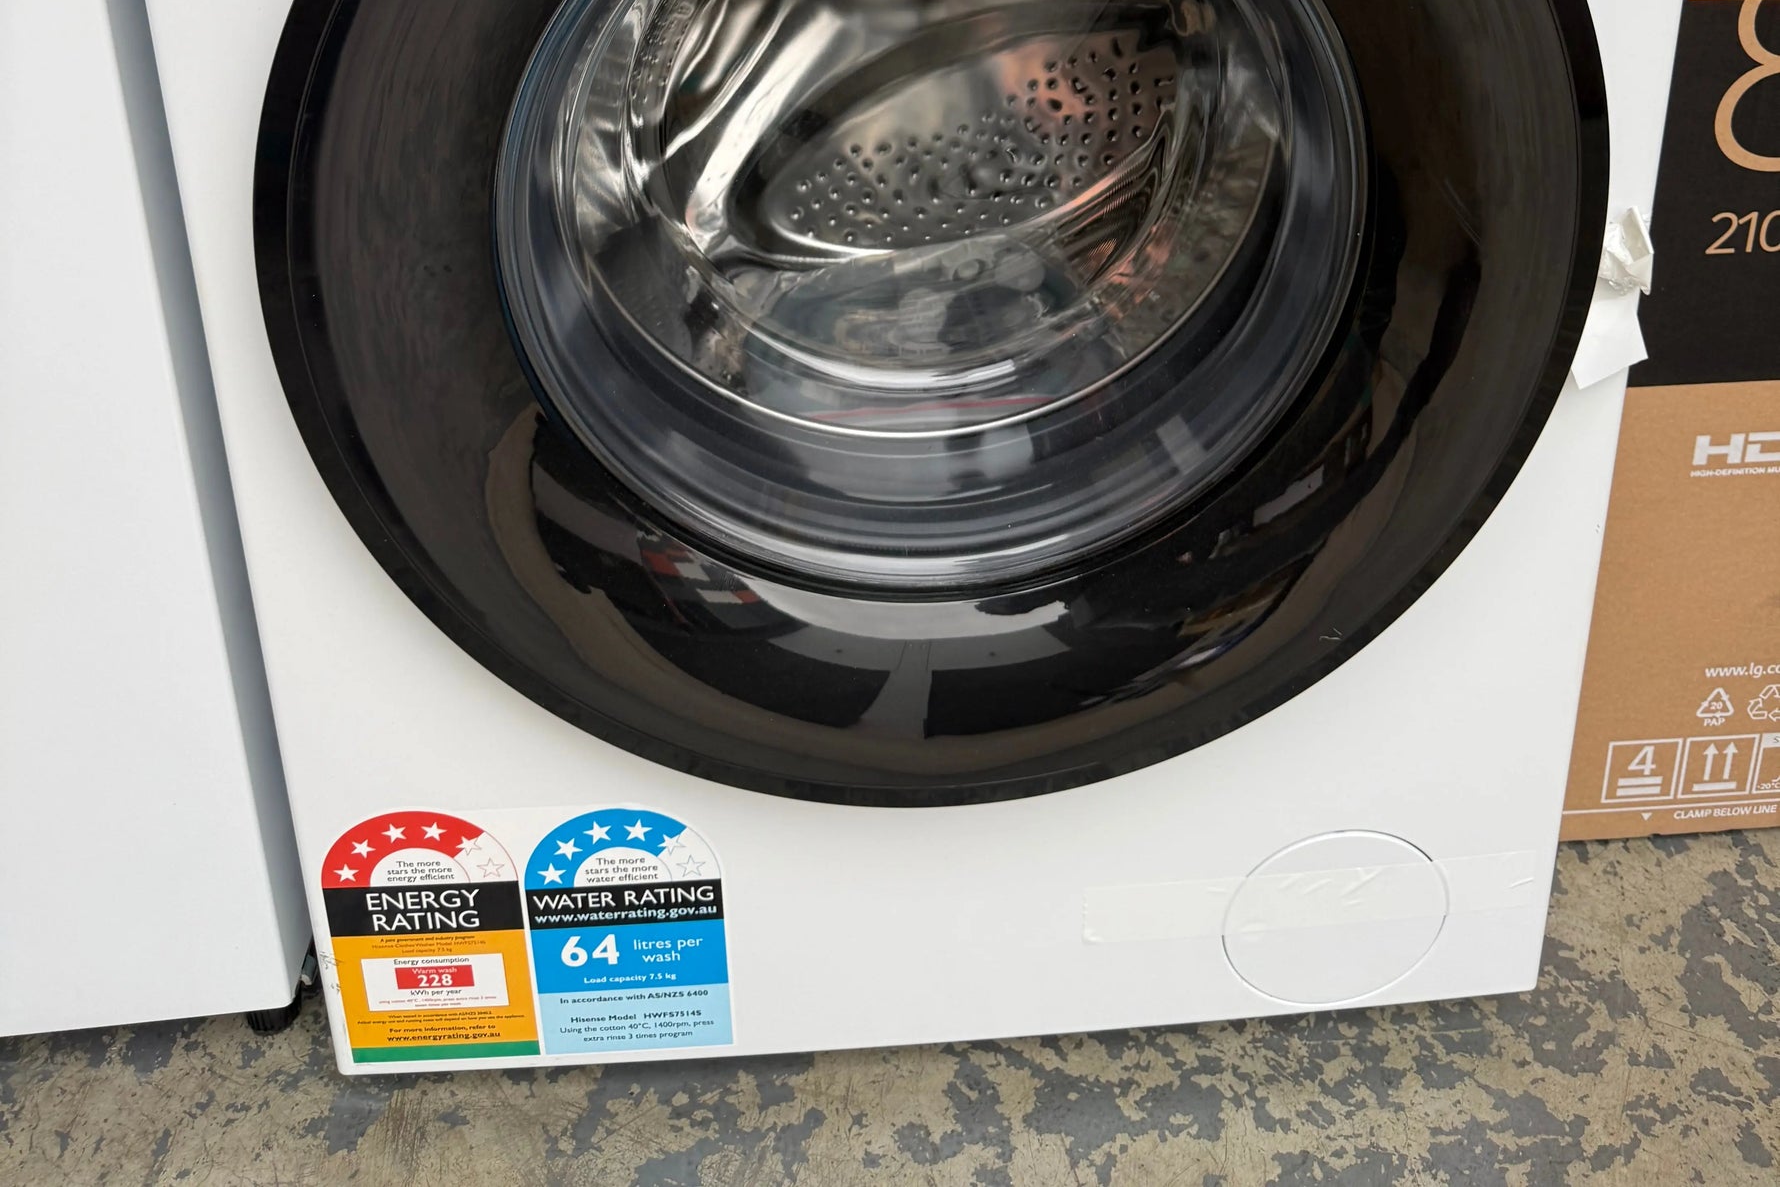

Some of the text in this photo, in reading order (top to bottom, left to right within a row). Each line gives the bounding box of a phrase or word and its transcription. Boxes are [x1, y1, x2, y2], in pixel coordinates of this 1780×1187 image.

[1690, 467, 1765, 477] HIGH-DEFINITION
[1710, 702, 1723, 710] 20
[1703, 718, 1726, 727] PAP
[1627, 745, 1656, 775] 4
[1673, 804, 1777, 820] CLAMP BELOW LINE
[596, 857, 616, 865] The
[585, 867, 609, 875] stars
[631, 865, 658, 873] more
[387, 873, 454, 883] energy efficient
[586, 873, 658, 883] water efficient
[365, 888, 480, 911] ENERGY
[532, 885, 714, 911] WATER RATING
[534, 904, 717, 924] www.waterrating.gov.au
[371, 910, 480, 932] RATING
[633, 938, 703, 951] litres per
[560, 933, 620, 968] 64
[393, 957, 470, 966] Energy consumption
[642, 951, 680, 963] wash
[417, 974, 453, 987] 228
[584, 976, 607, 984] Load
[609, 974, 647, 984] capacity
[665, 972, 677, 981] kg
[410, 989, 430, 997] kWh
[571, 995, 623, 1004] accordance
[647, 991, 685, 1000] AS/NZS
[570, 1016, 607, 1024] Hisense
[387, 1032, 501, 1042] www.energyrating.gov.au
[659, 1031, 693, 1039] program
